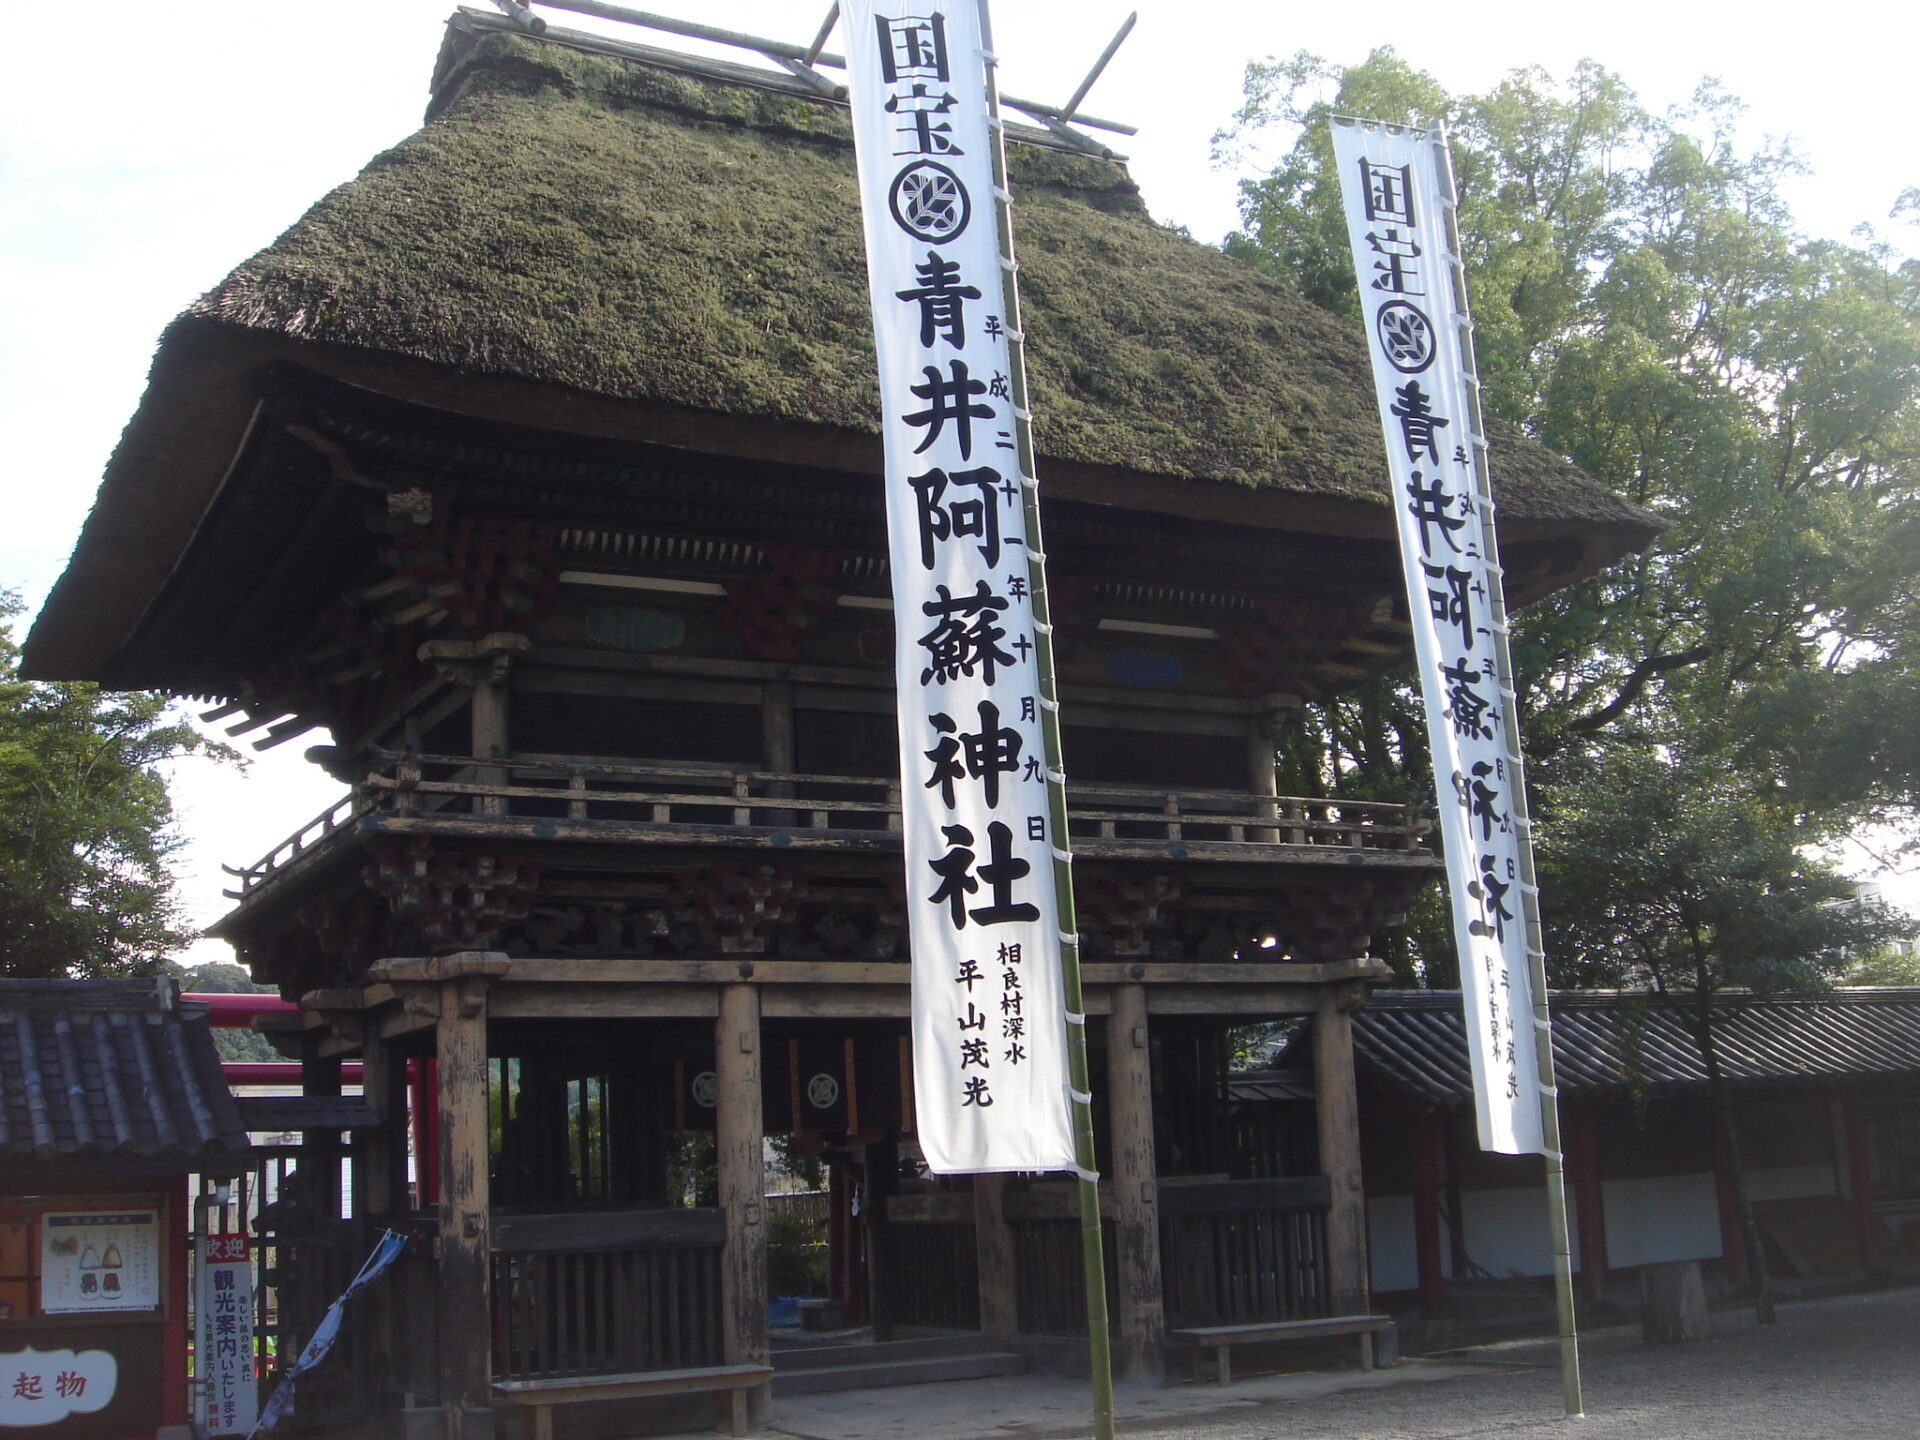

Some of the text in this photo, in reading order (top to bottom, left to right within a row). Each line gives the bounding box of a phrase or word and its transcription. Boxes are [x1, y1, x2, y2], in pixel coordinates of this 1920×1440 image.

[874, 12, 1041, 931] 国宝 青井阿蘇神社
[983, 314, 1047, 842] 平成二十一年十月九日
[954, 960, 994, 1108] 平山茂光
[997, 941, 1027, 1064] 相良村深水
[0, 1371, 88, 1400] 起物
[214, 1269, 237, 1427] 観光案内いたします
